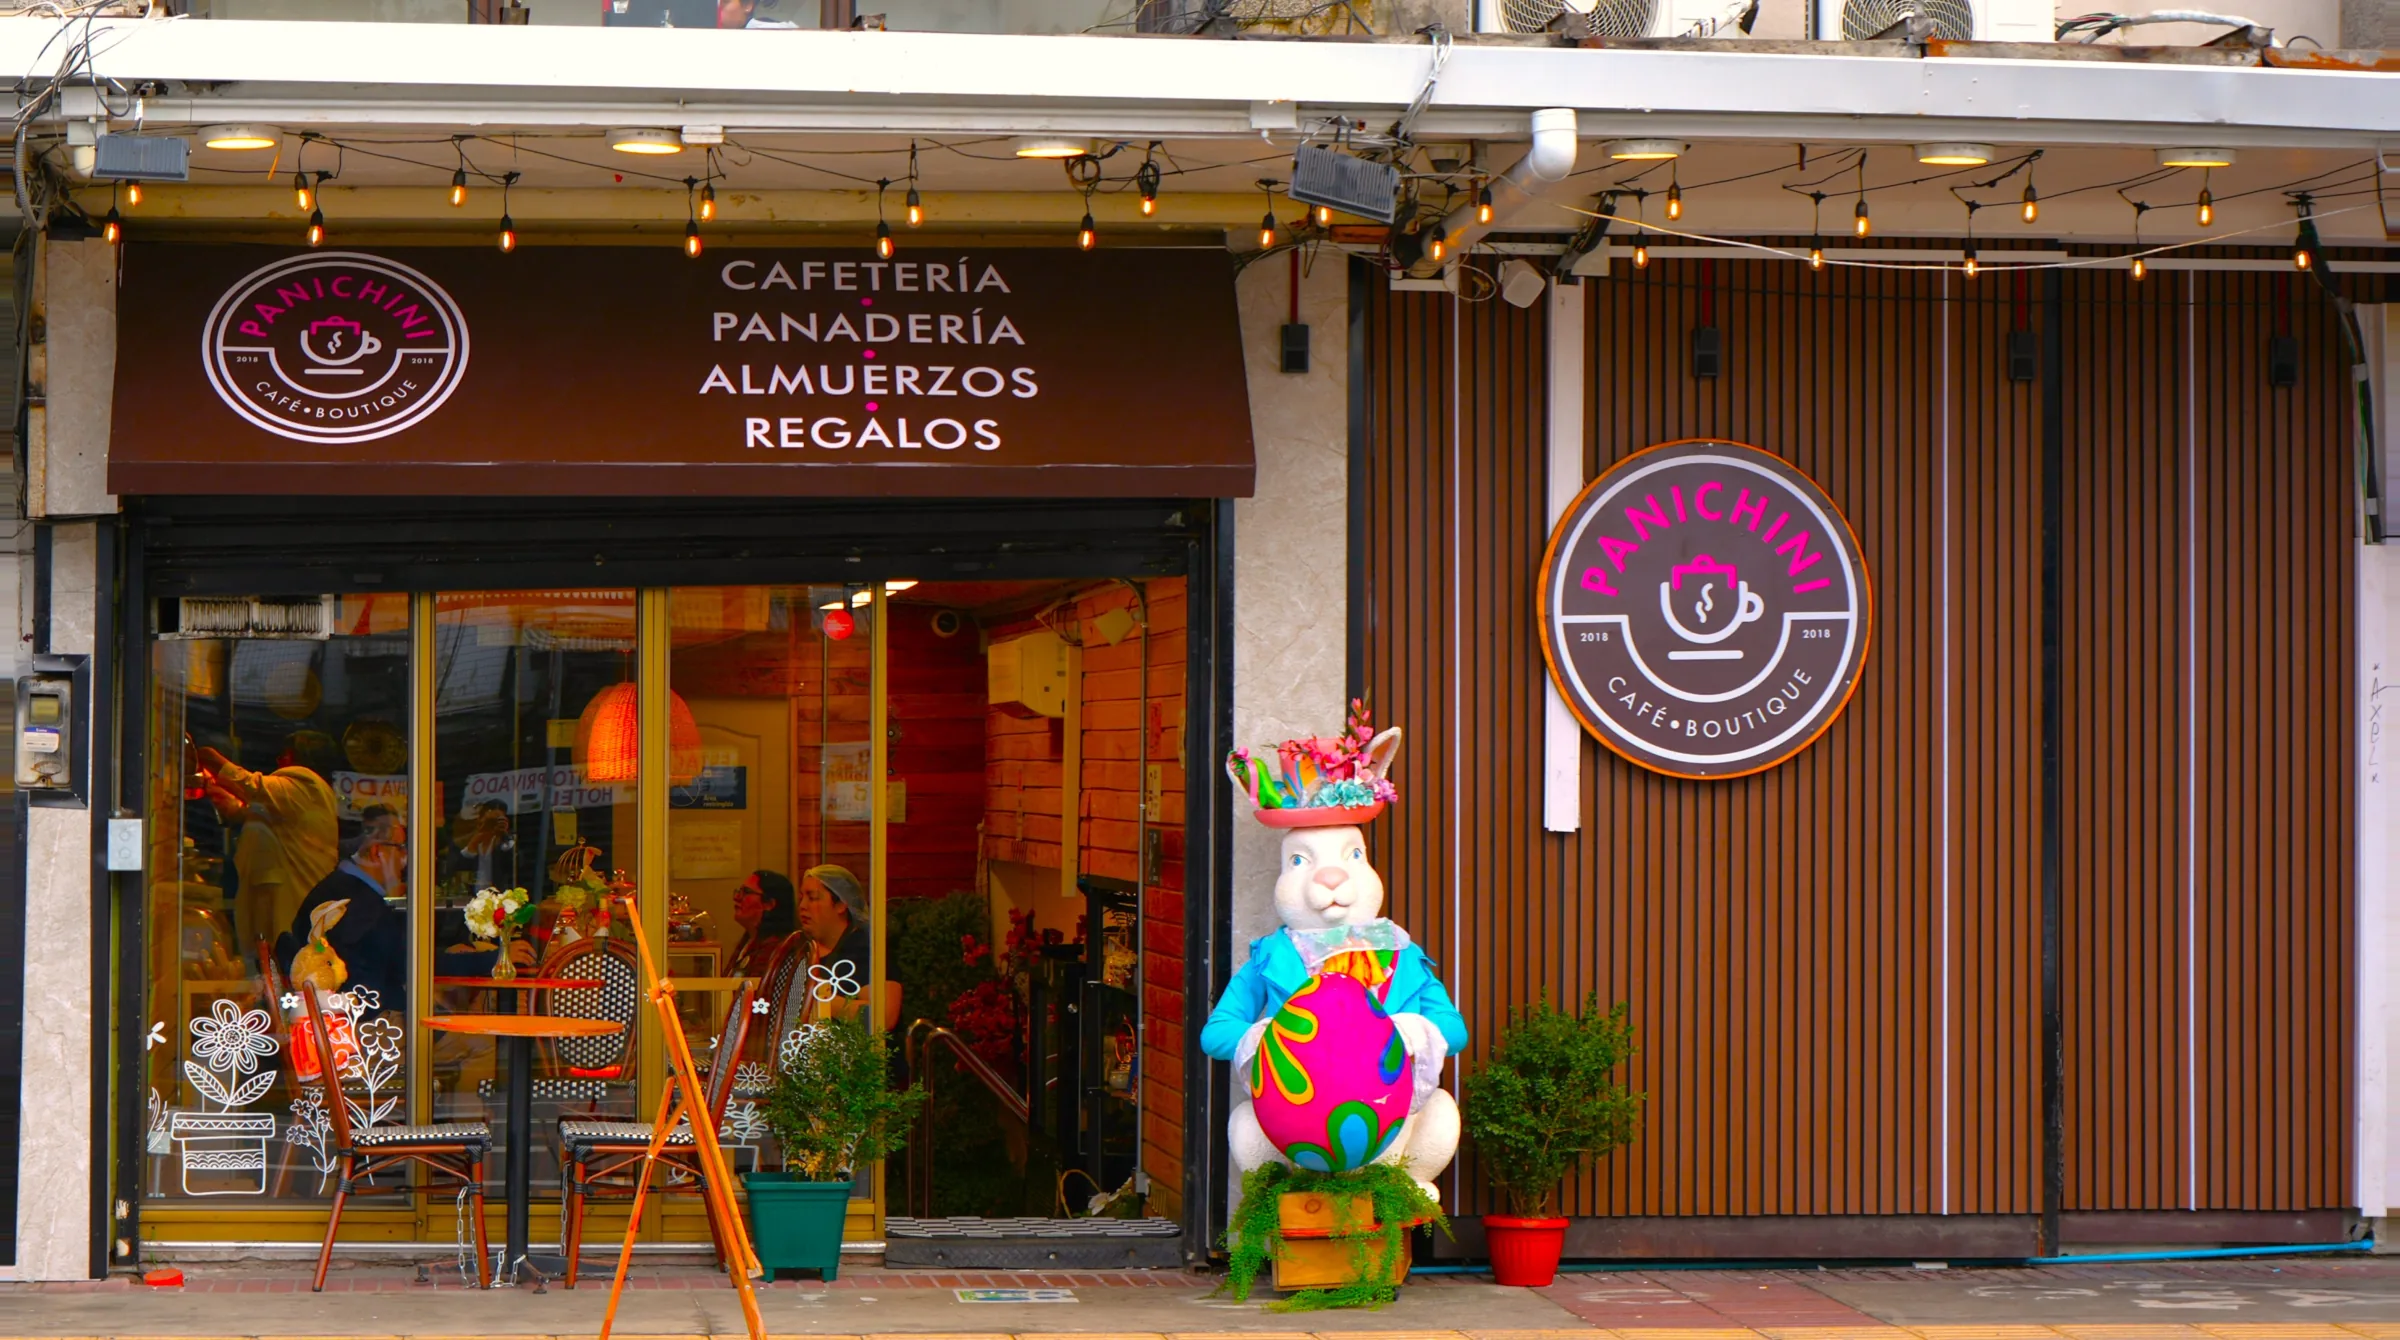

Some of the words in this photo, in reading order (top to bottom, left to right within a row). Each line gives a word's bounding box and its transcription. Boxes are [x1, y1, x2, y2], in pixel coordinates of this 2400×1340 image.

[721, 256, 1012, 294] CAFETERÍA
[239, 275, 436, 339] PANICHINI
[712, 308, 1026, 346] PANADERÍA
[411, 357, 434, 365] 2018
[256, 381, 302, 413] CAFÉ
[315, 379, 418, 419] BOUTIQUE
[698, 364, 1039, 399] ALMUERZOS
[745, 417, 1001, 451] REGALOS
[1580, 481, 1832, 597] PANICHINI
[1580, 632, 1609, 642] 2018
[1802, 628, 1831, 639] 2018
[1608, 676, 1667, 729] CAFÉ
[1685, 668, 1812, 739] BOUTIQUE
